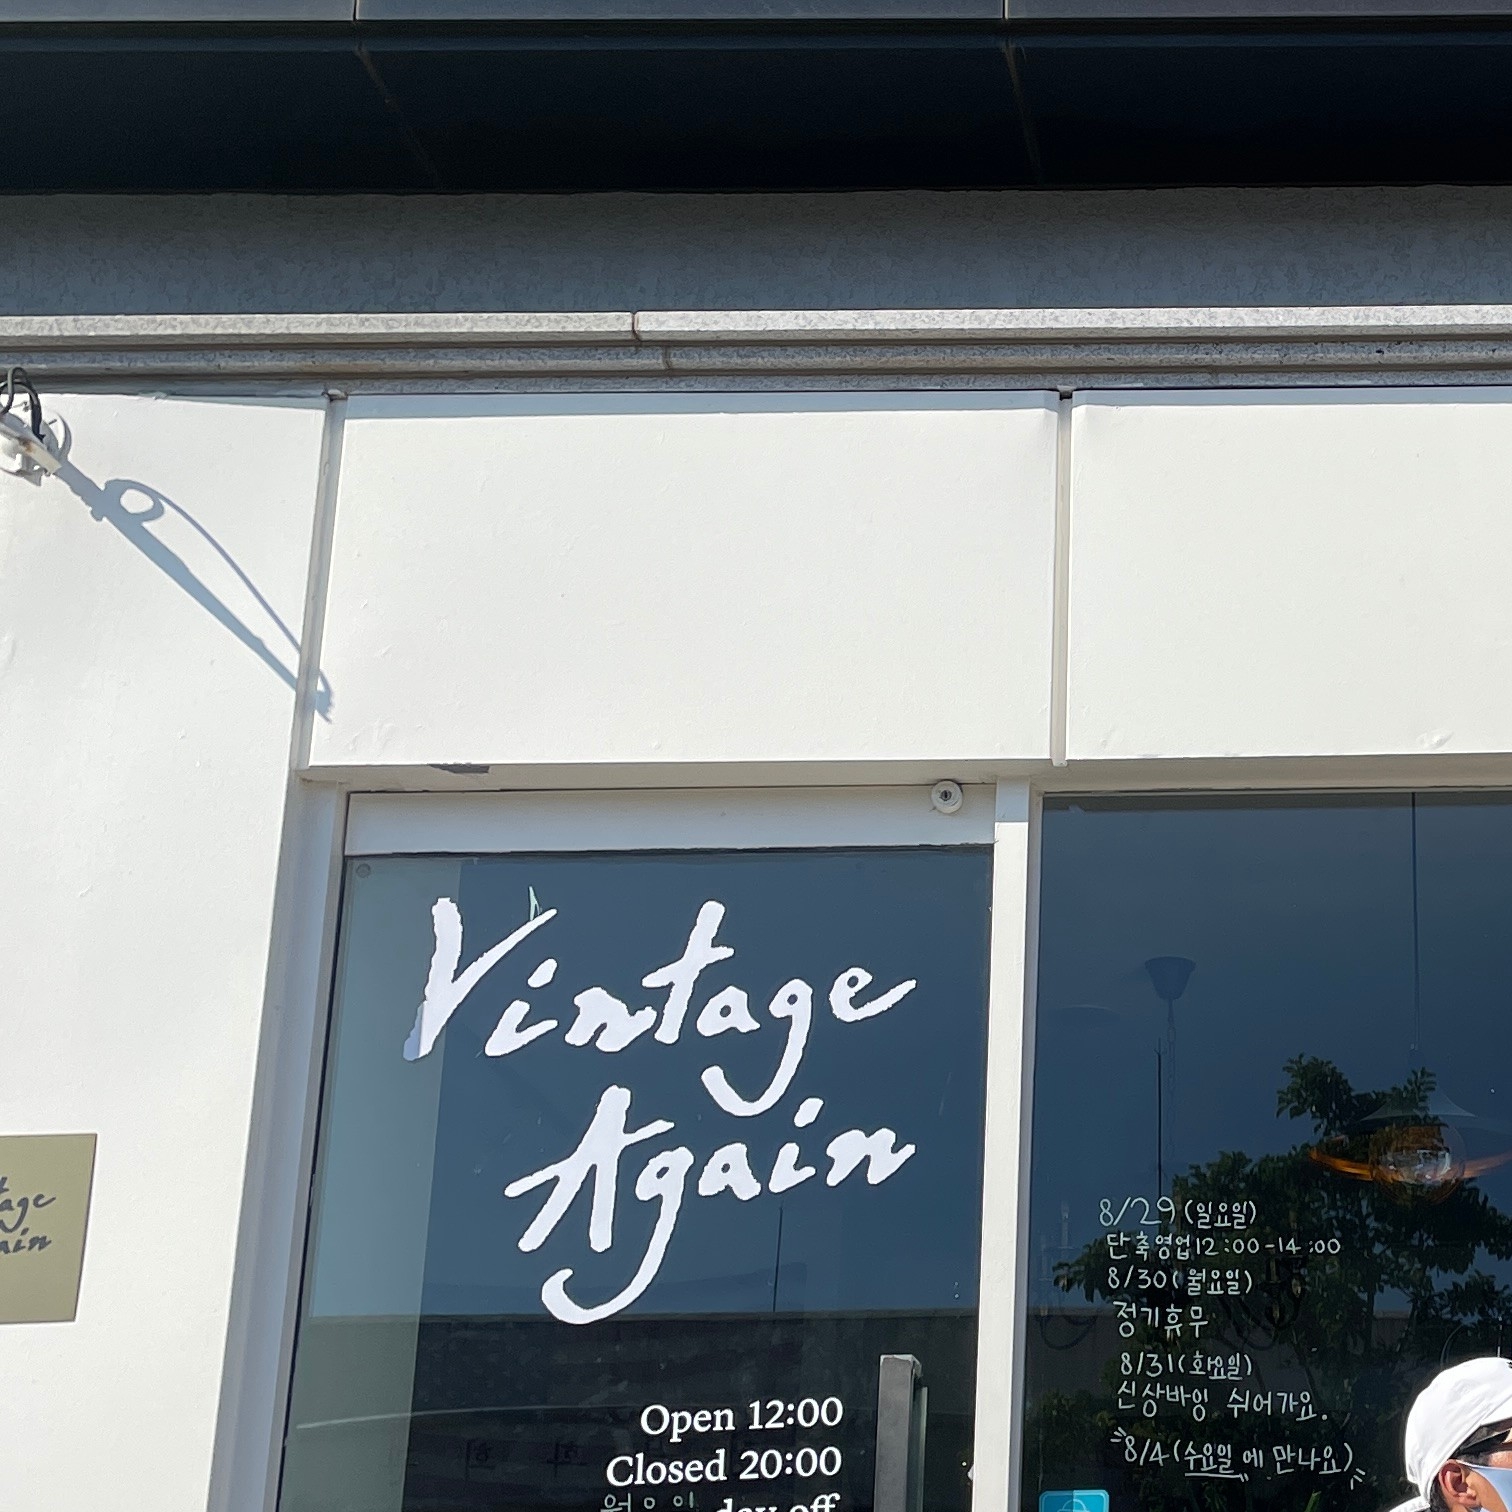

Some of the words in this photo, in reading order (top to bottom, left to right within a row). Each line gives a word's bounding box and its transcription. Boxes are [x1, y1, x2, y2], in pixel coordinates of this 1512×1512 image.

[403, 897, 917, 1117] Vintage
[504, 1085, 916, 1325] Again
[1112, 1300, 1209, 1339] 정기휴무
[640, 1404, 736, 1442] Open
[748, 1396, 844, 1431] 12:00
[1117, 1380, 1209, 1422] 신상바잉
[606, 1449, 727, 1487] Closed
[738, 1446, 842, 1482] 20:00
